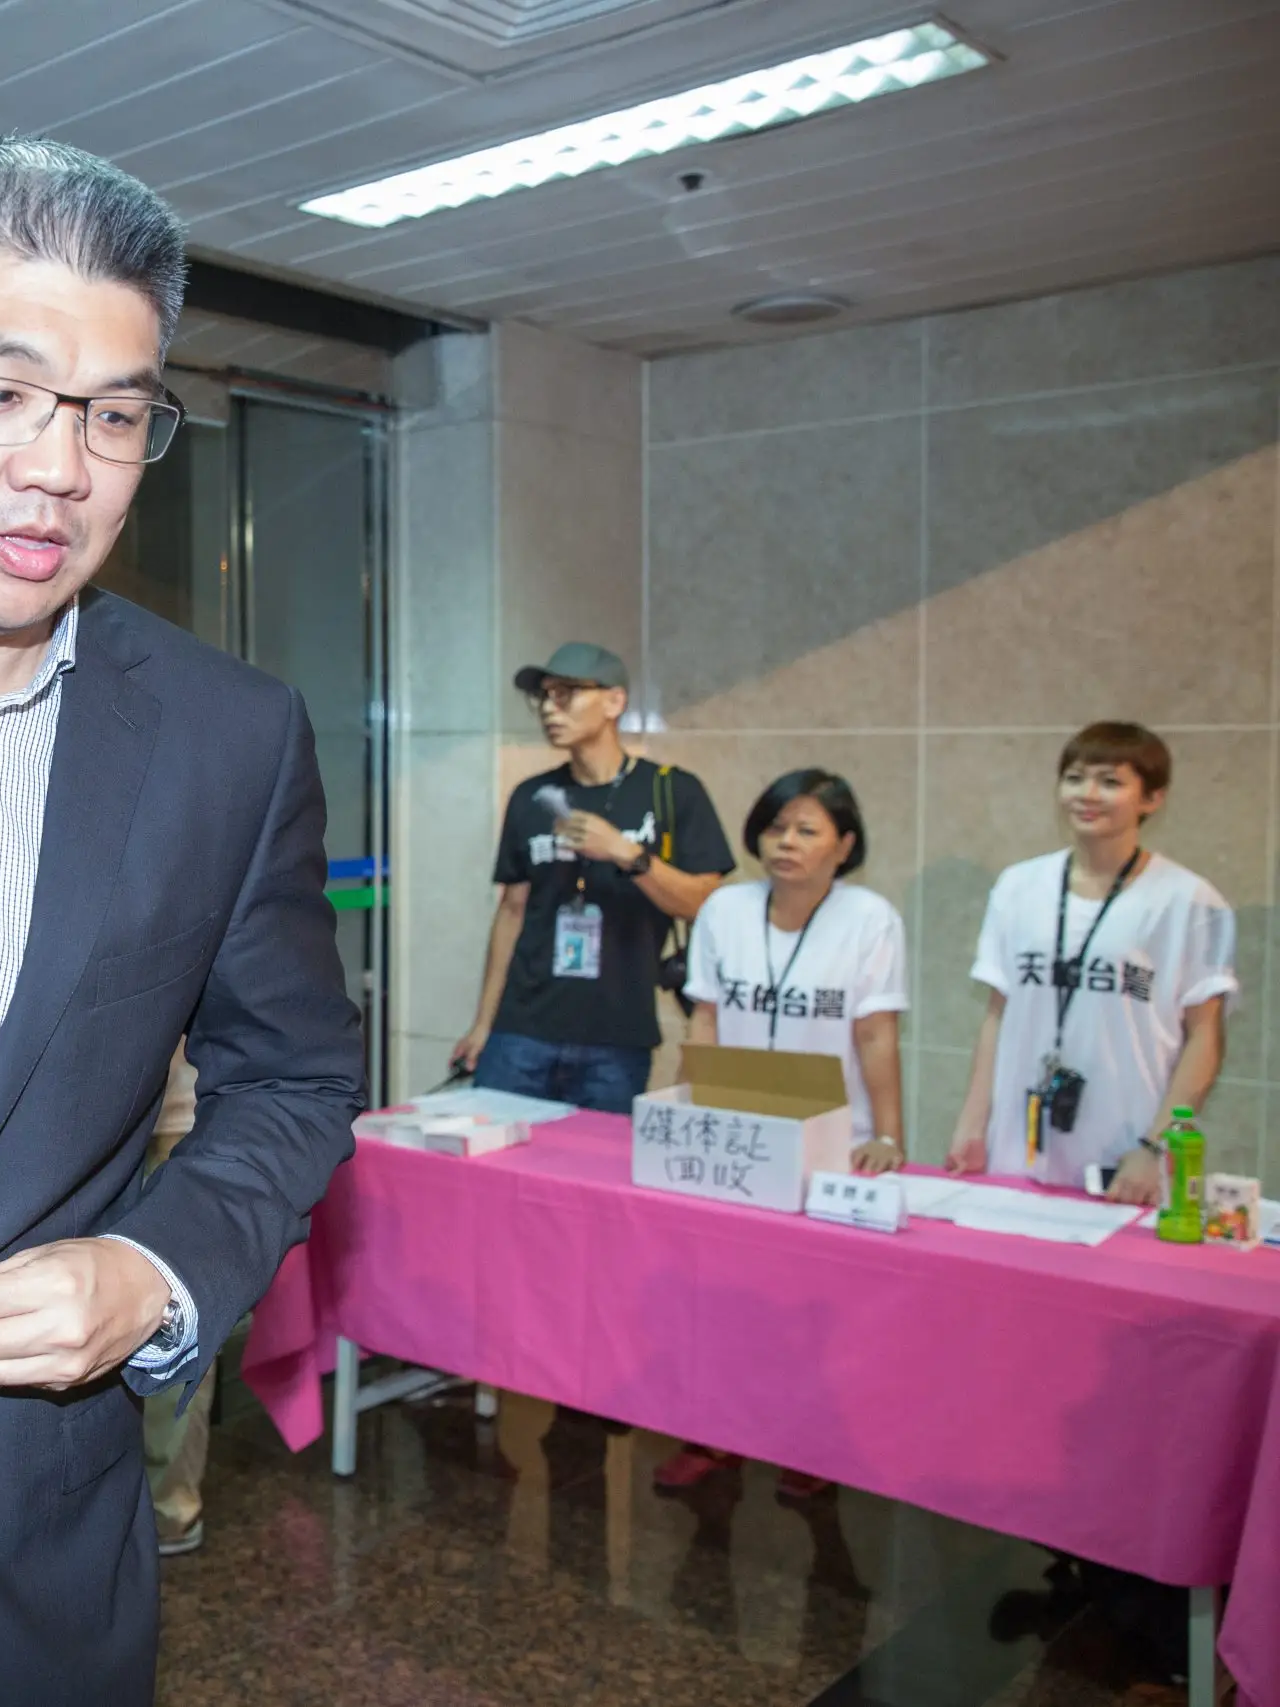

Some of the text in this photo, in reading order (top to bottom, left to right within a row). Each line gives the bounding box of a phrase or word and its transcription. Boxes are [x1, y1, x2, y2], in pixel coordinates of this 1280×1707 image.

[1017, 952, 1155, 1002] 天台灣
[664, 1156, 753, 1197] 回收
